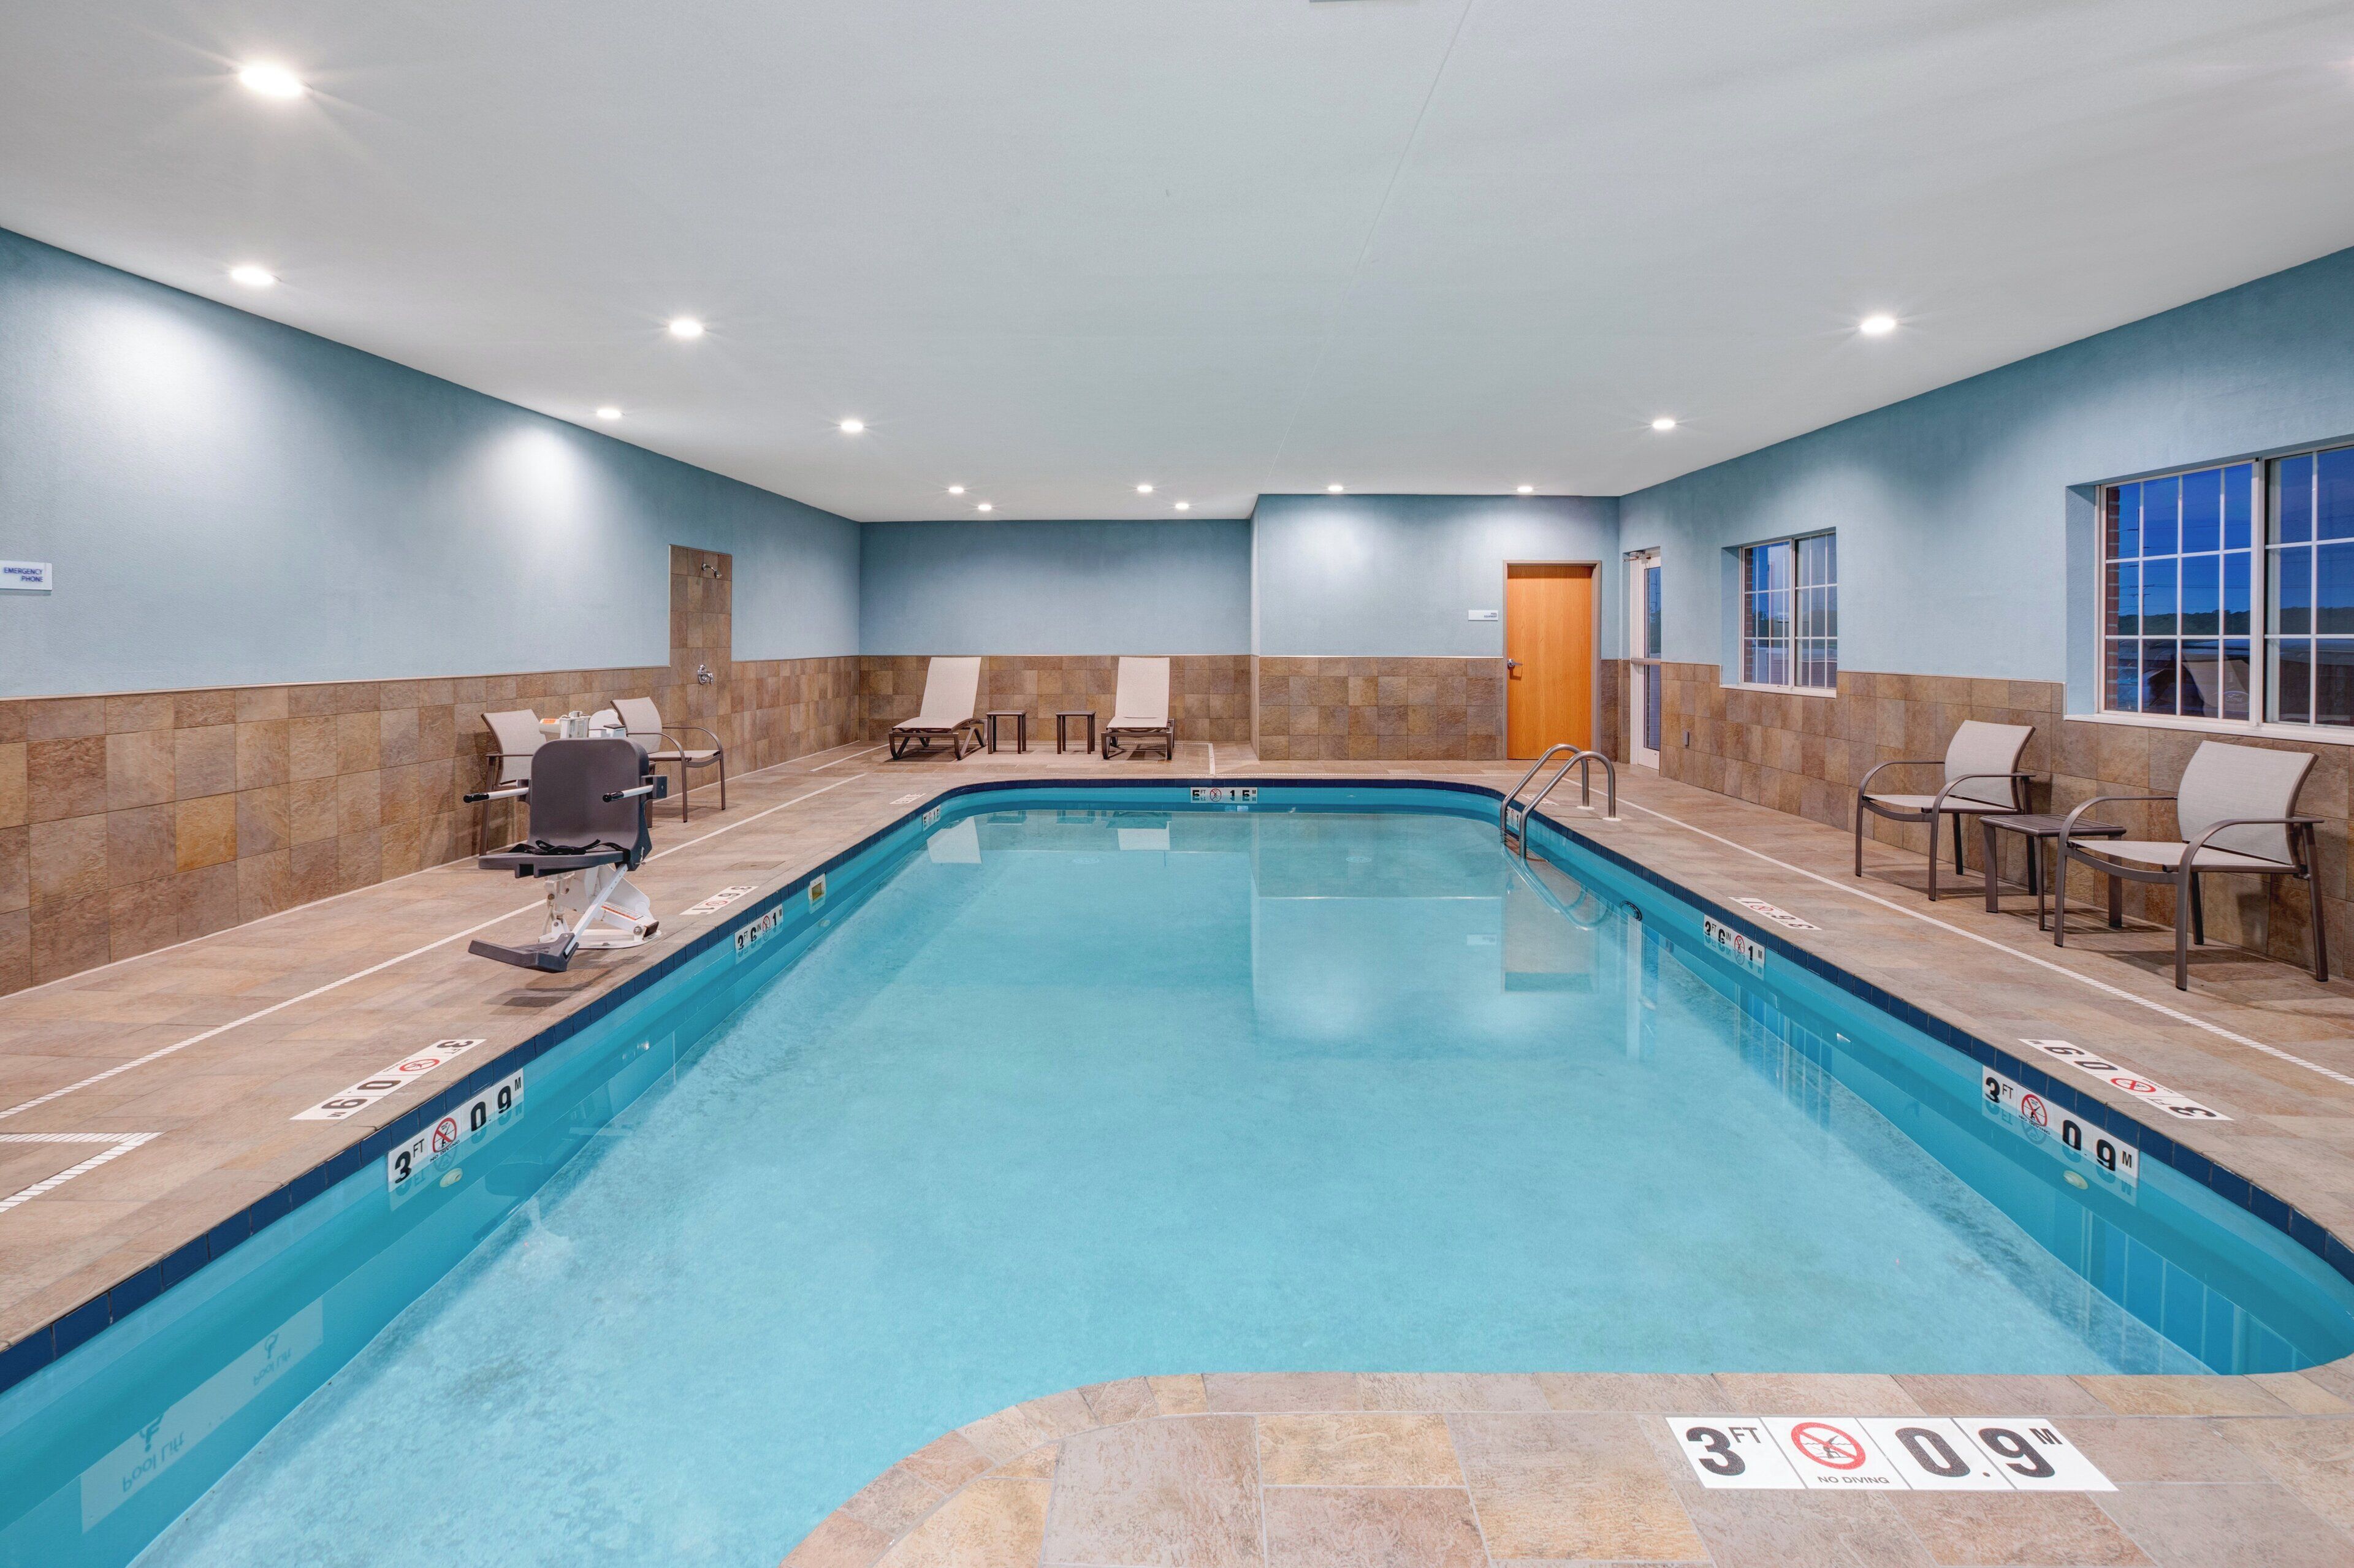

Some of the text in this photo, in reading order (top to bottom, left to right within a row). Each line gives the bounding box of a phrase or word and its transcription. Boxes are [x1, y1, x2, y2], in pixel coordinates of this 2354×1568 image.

[395, 1151, 412, 1184] 3
[413, 1138, 425, 1158] FT
[514, 1076, 521, 1091] M
[1986, 1077, 2000, 1103] 3
[2002, 1083, 2014, 1099] FT
[2122, 1151, 2132, 1168] M
[2028, 1121, 2051, 1135] DIVING
[440, 1140, 460, 1155] DIVING
[1686, 1426, 1746, 1476] 3
[1728, 1426, 1761, 1444] FT
[2028, 1428, 2063, 1445] M
[1842, 1476, 1891, 1485] DIVING
